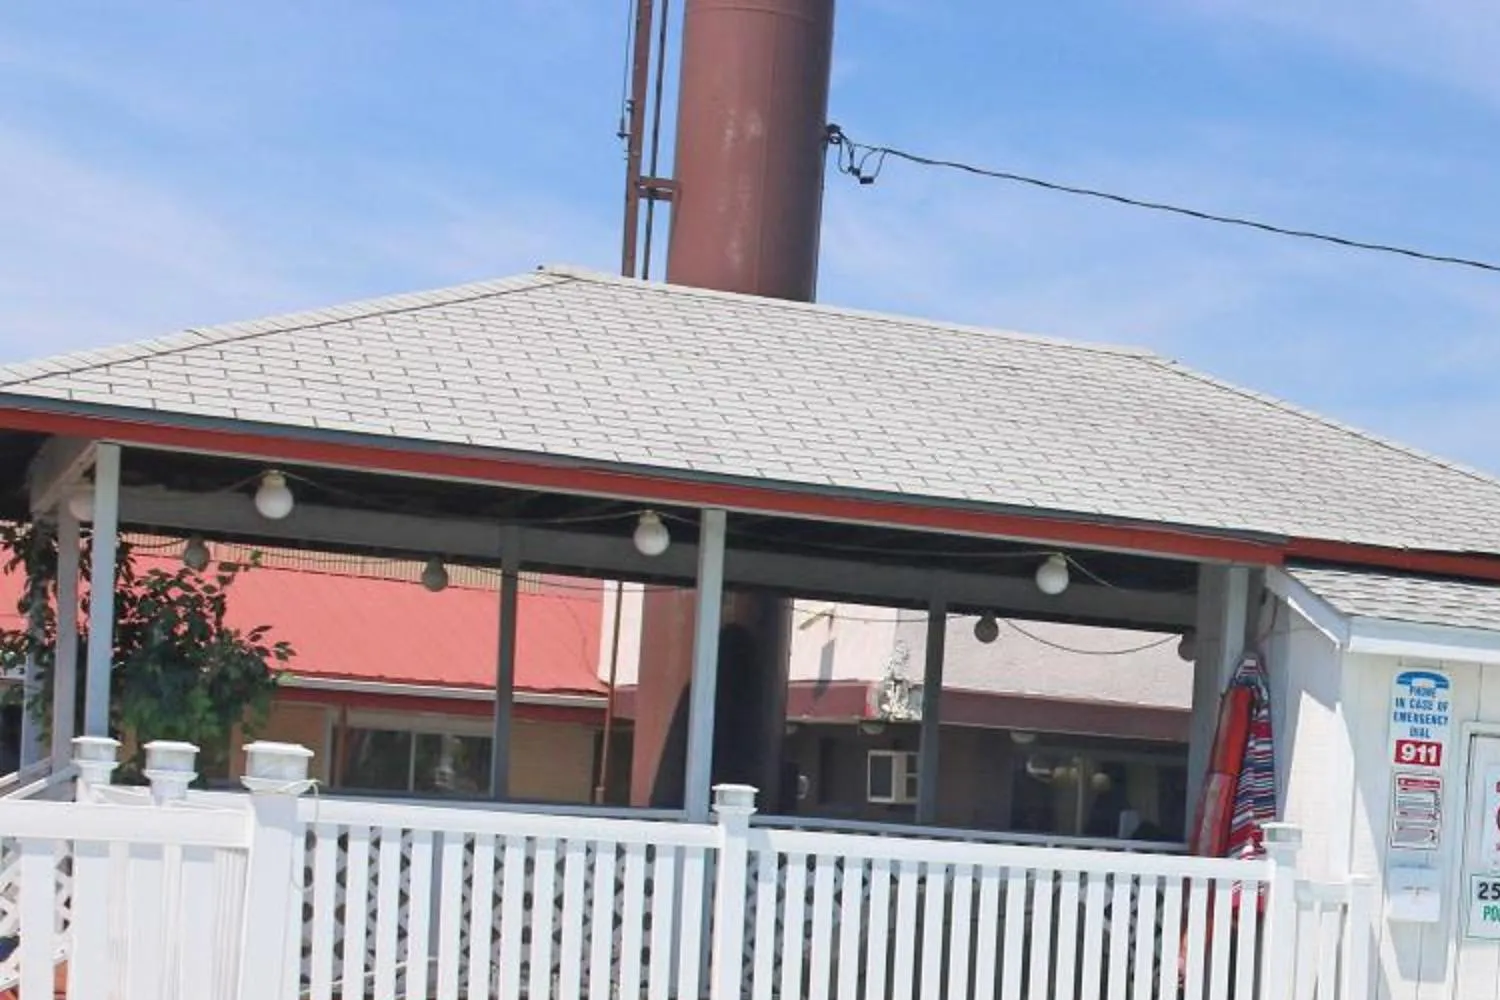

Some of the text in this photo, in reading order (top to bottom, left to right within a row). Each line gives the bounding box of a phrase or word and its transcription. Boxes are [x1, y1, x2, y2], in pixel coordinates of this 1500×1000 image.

[1395, 697, 1405, 708] IN
[1438, 701, 1448, 712] OF
[1393, 711, 1448, 725] EMERGENCY
[1409, 727, 1430, 738] DIAL
[1401, 743, 1437, 763] 911
